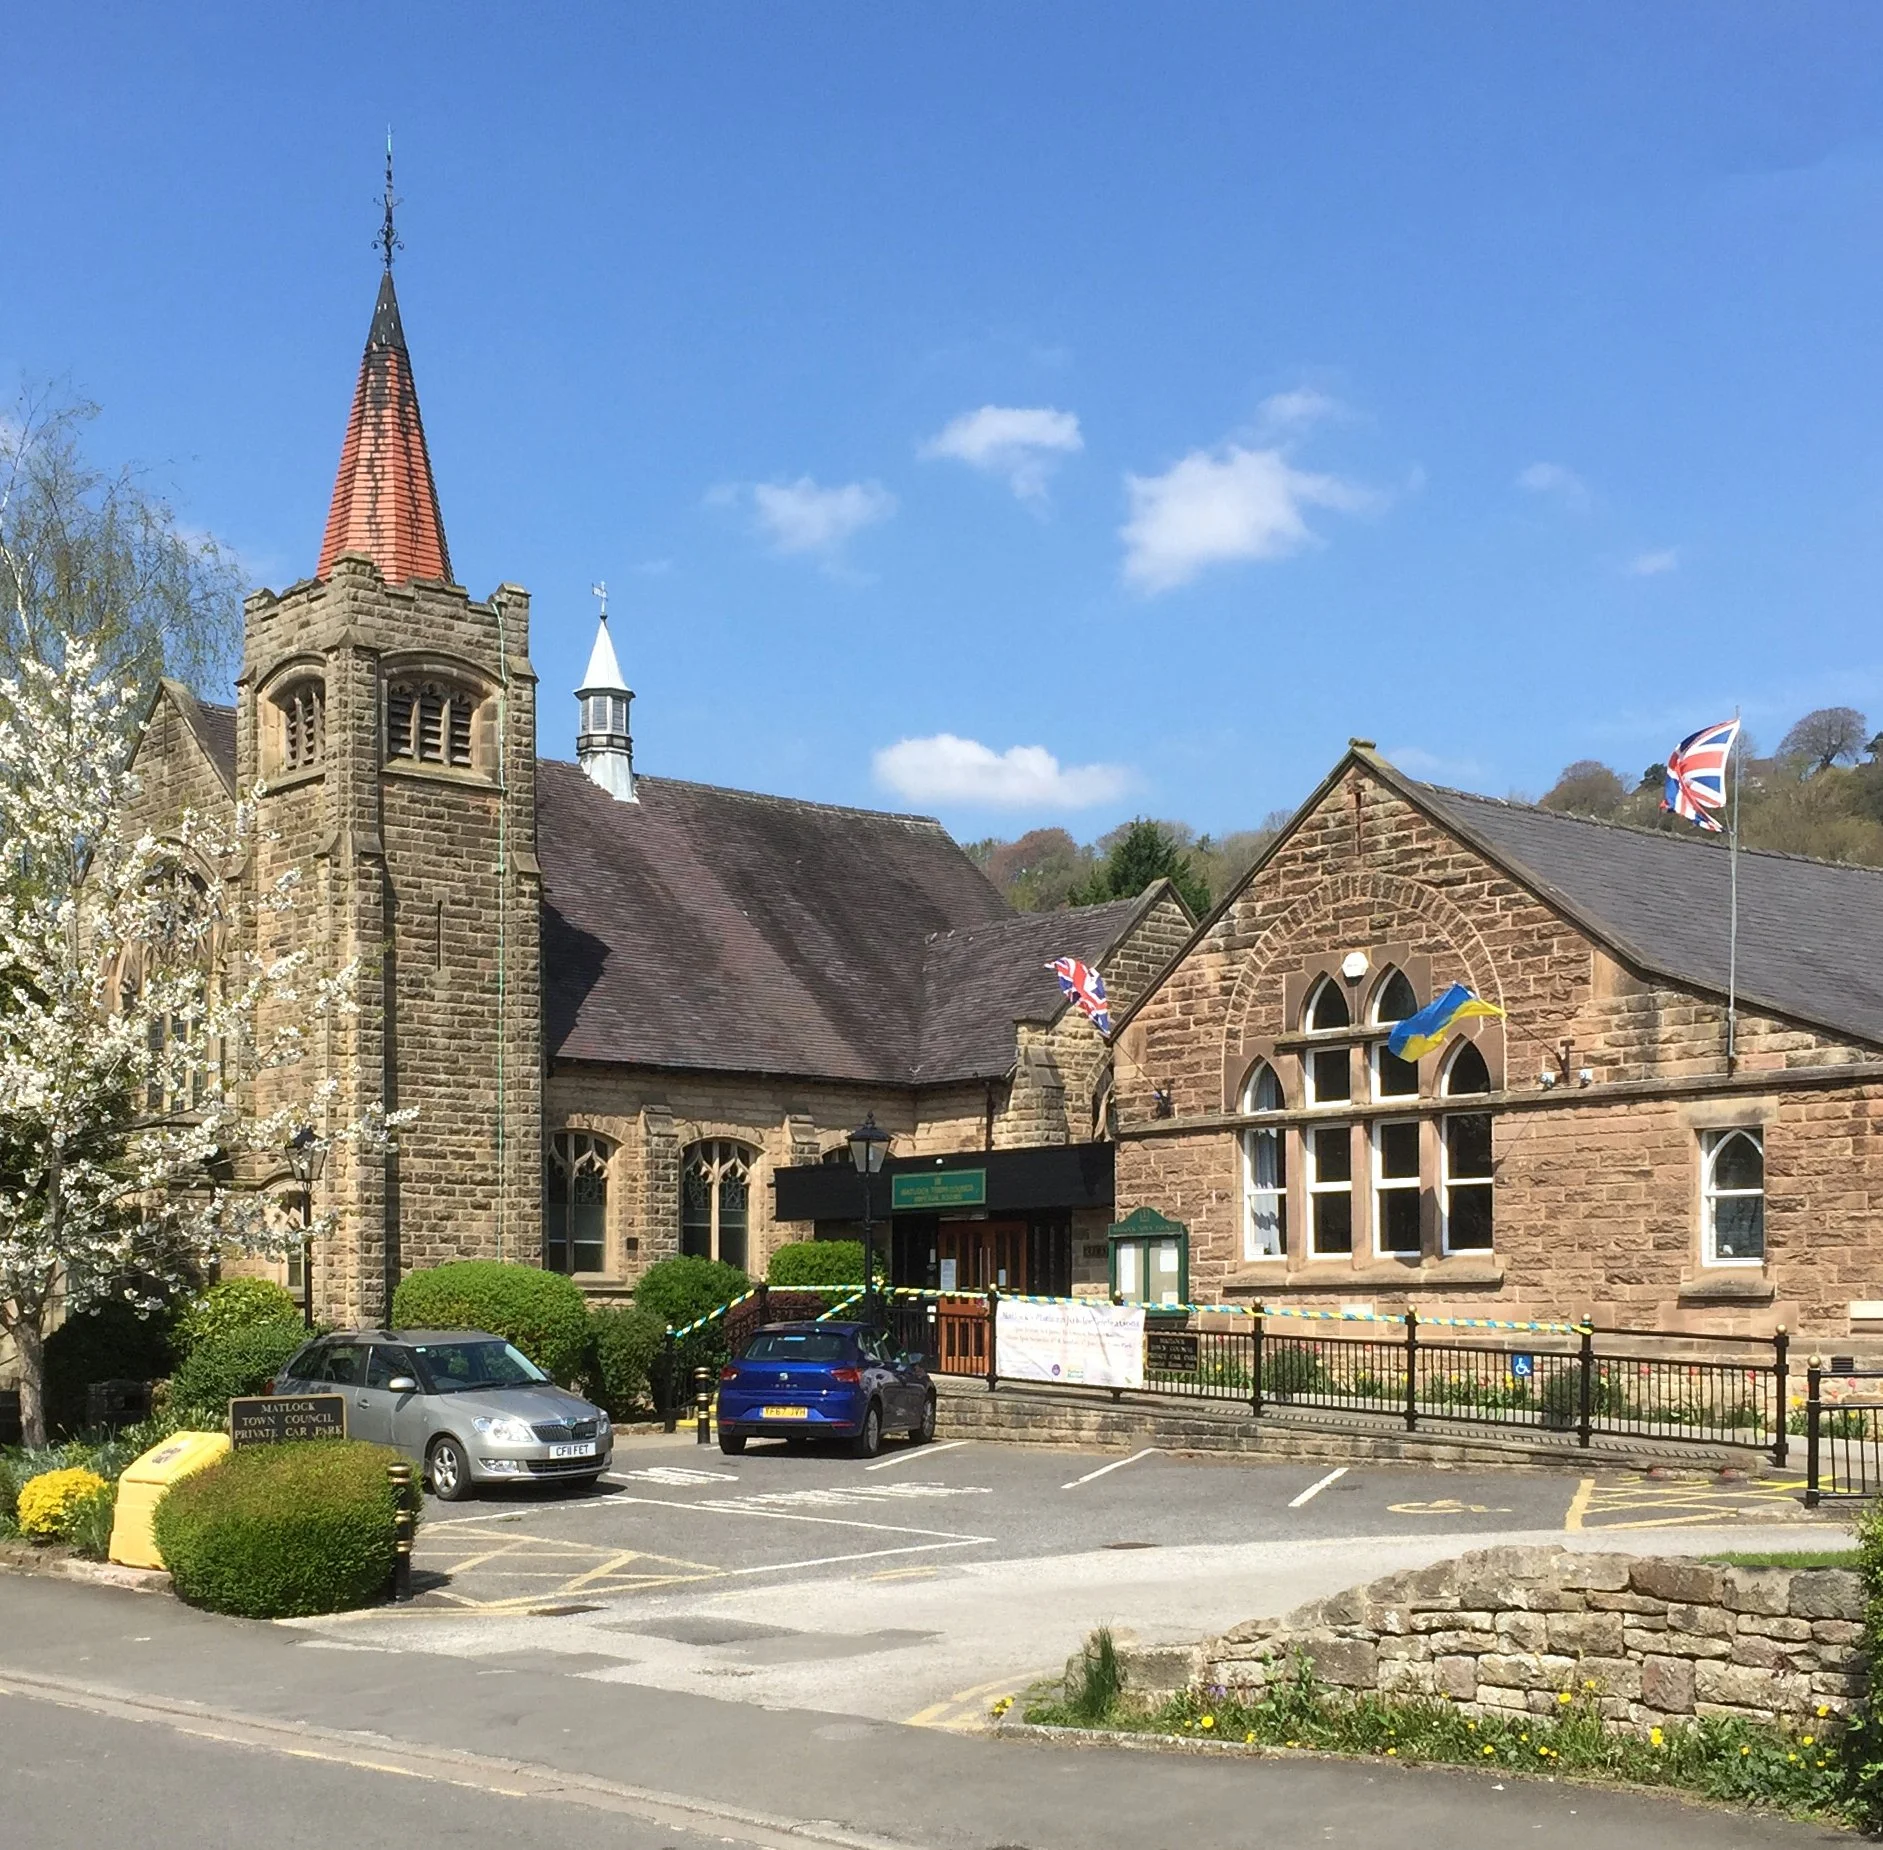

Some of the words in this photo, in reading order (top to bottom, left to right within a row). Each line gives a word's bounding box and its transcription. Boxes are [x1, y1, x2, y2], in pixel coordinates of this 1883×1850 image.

[260, 1402, 316, 1414] MATLOCK
[241, 1416, 277, 1427] TOWN
[284, 1413, 335, 1425] COUNCIL
[234, 1428, 278, 1440] PRIVATE
[285, 1427, 308, 1437] CAR
[314, 1425, 343, 1437] PARK
[556, 1446, 572, 1457] CF11
[573, 1444, 589, 1455] FET
